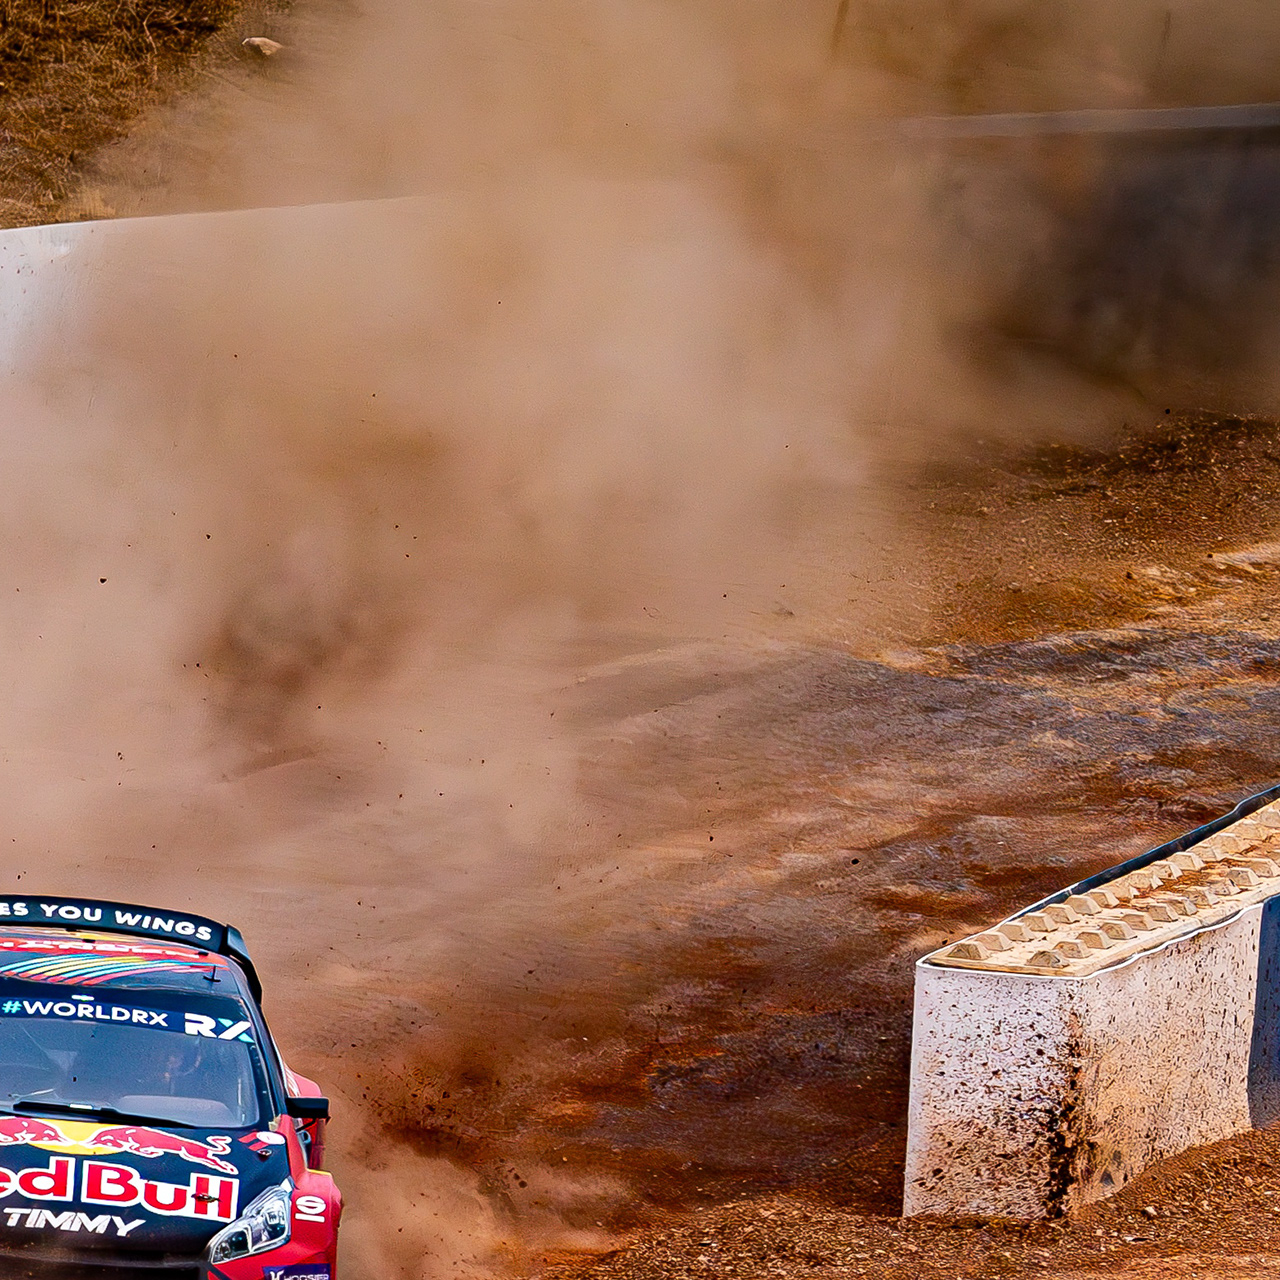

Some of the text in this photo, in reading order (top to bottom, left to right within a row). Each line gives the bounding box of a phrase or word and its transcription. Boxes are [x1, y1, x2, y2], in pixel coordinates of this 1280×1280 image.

[39, 903, 102, 922] YOU
[114, 910, 213, 941] WINGS
[1, 1000, 169, 1028] #WORLDRX
[184, 1012, 255, 1044] RX
[81, 1161, 240, 1223] Bull
[3, 1207, 146, 1238] TIMMY
